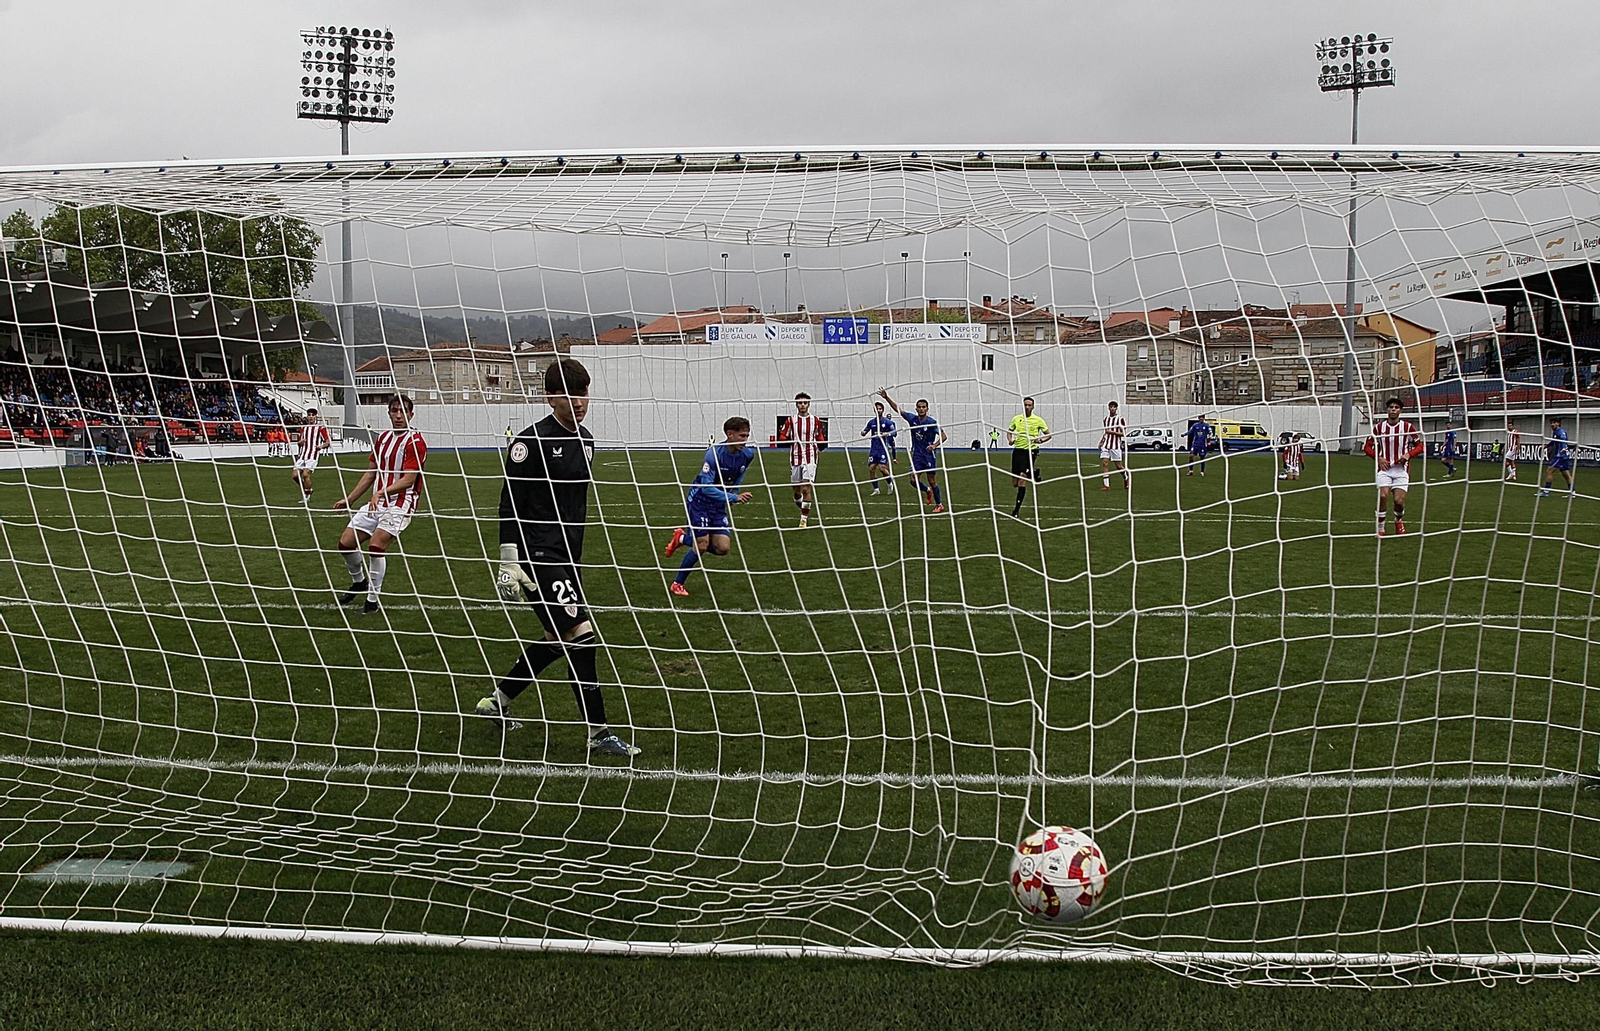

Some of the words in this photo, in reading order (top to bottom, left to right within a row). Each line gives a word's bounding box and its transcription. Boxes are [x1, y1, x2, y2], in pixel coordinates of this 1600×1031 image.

[838, 326, 844, 335] 0
[849, 326, 854, 335] 1
[552, 580, 578, 604] 25
